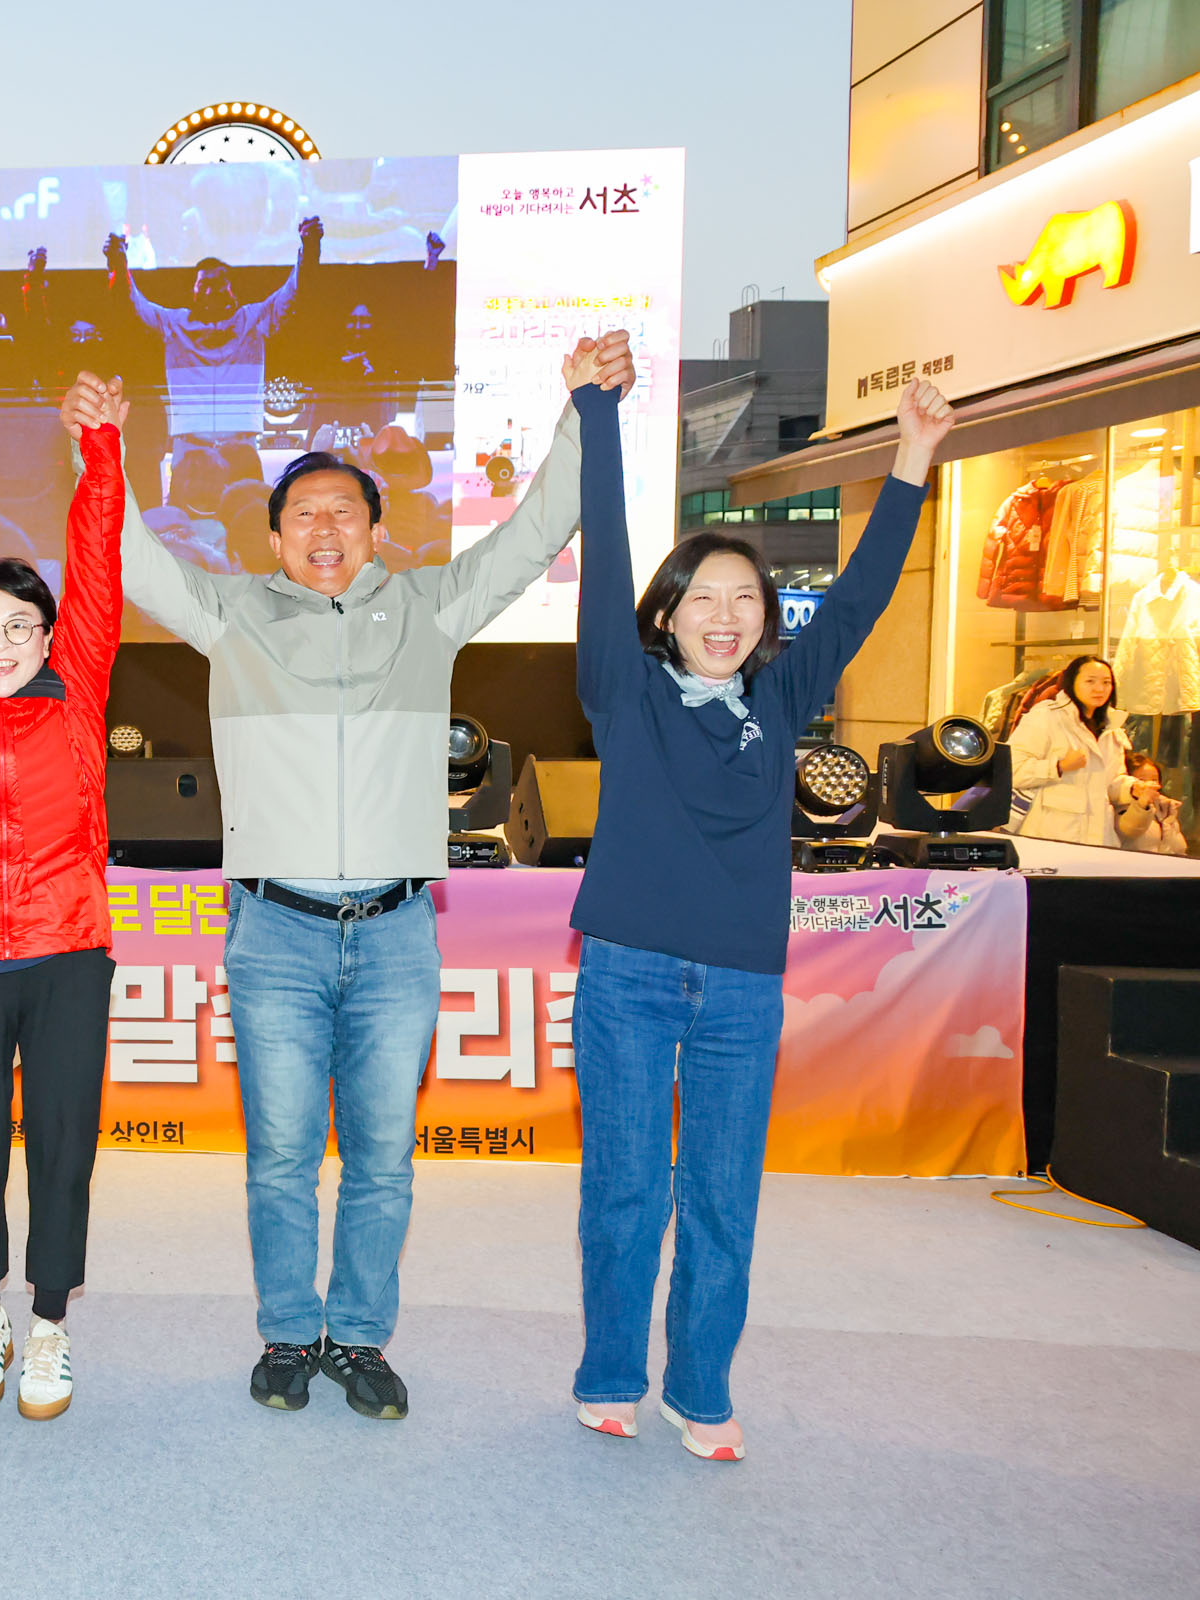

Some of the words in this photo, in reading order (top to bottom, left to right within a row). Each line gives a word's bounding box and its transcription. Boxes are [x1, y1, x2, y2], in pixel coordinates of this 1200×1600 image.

[501, 188, 523, 201] 오늘
[529, 187, 575, 200] 행복하고
[579, 183, 640, 214] 서초
[480, 203, 514, 217] 내일이
[519, 202, 574, 216] 기다려지는
[870, 360, 917, 392] 독립문
[371, 612, 387, 622] K2
[790, 898, 807, 912] 늘
[812, 897, 870, 912] 행복하고
[874, 893, 947, 931] 서초
[802, 915, 870, 931] 기다려지는
[110, 1121, 184, 1145] 상인회
